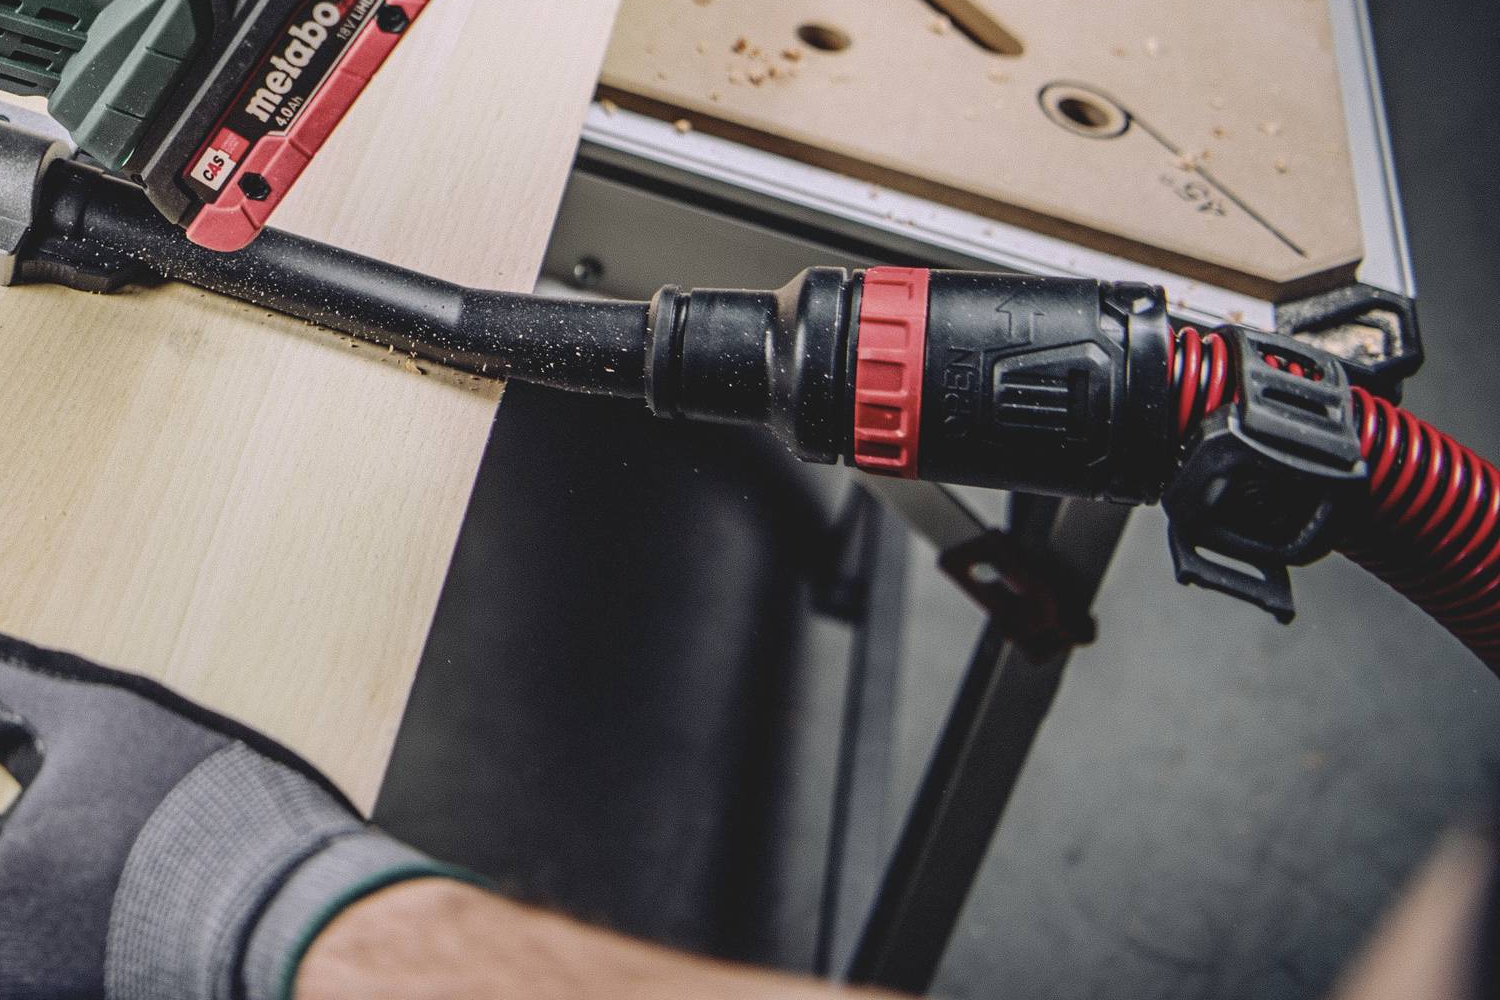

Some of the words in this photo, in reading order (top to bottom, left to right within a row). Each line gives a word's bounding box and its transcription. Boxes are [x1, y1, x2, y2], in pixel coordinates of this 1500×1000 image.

[336, 18, 357, 40] 18V
[245, 2, 341, 123] metabo
[203, 155, 225, 181] CAS
